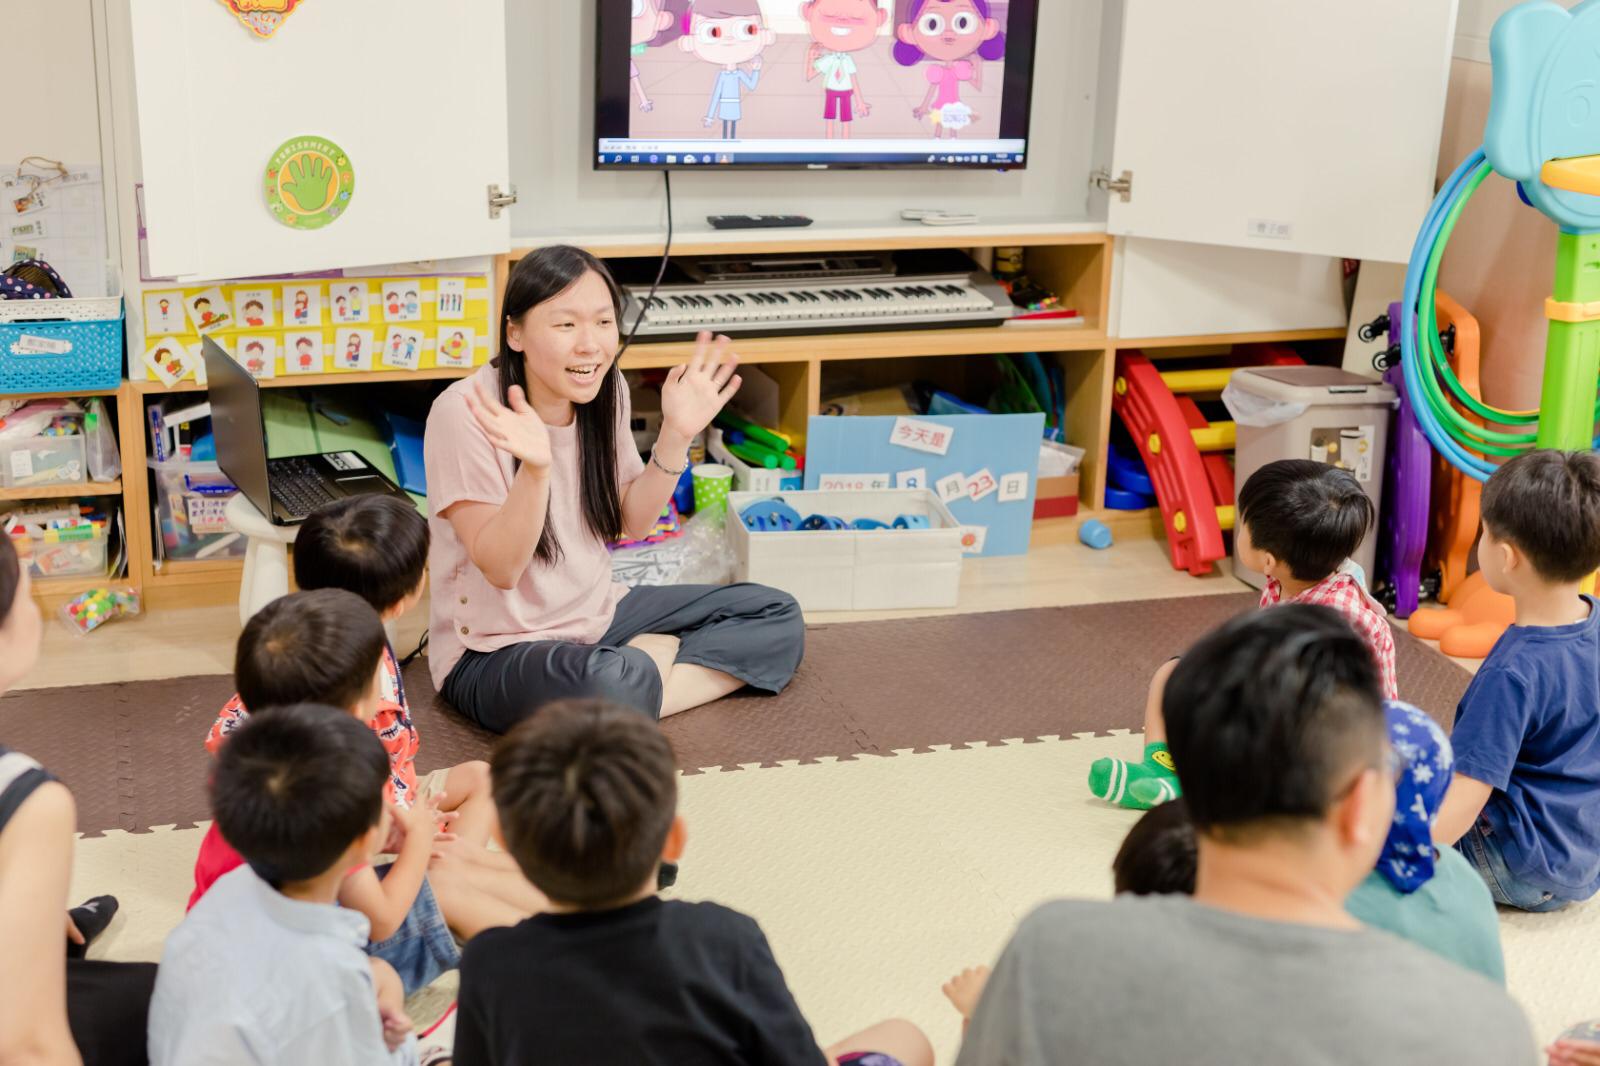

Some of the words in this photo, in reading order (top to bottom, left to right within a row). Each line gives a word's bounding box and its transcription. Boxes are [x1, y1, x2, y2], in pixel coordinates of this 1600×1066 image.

[898, 425, 945, 448] 今天是
[906, 477, 917, 489] 8
[945, 480, 961, 496] 月
[967, 475, 994, 497] 23
[1007, 480, 1020, 494] 日
